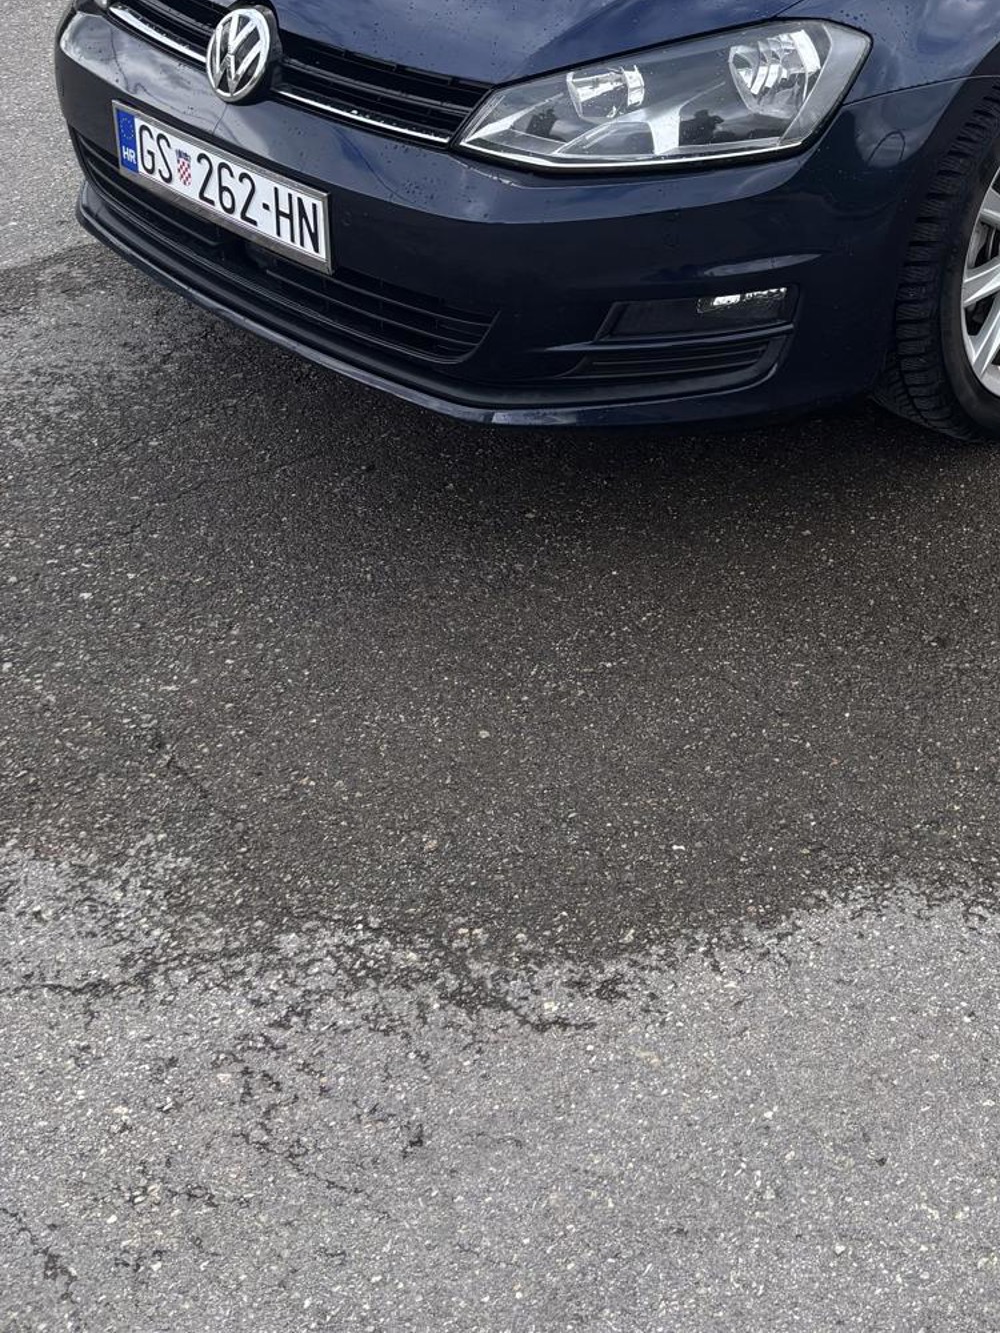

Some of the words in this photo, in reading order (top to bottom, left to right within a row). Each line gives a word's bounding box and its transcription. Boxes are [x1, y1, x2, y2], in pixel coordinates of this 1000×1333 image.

[121, 147, 137, 164] HR
[138, 123, 174, 184] GS
[196, 152, 321, 254] 262-HN
